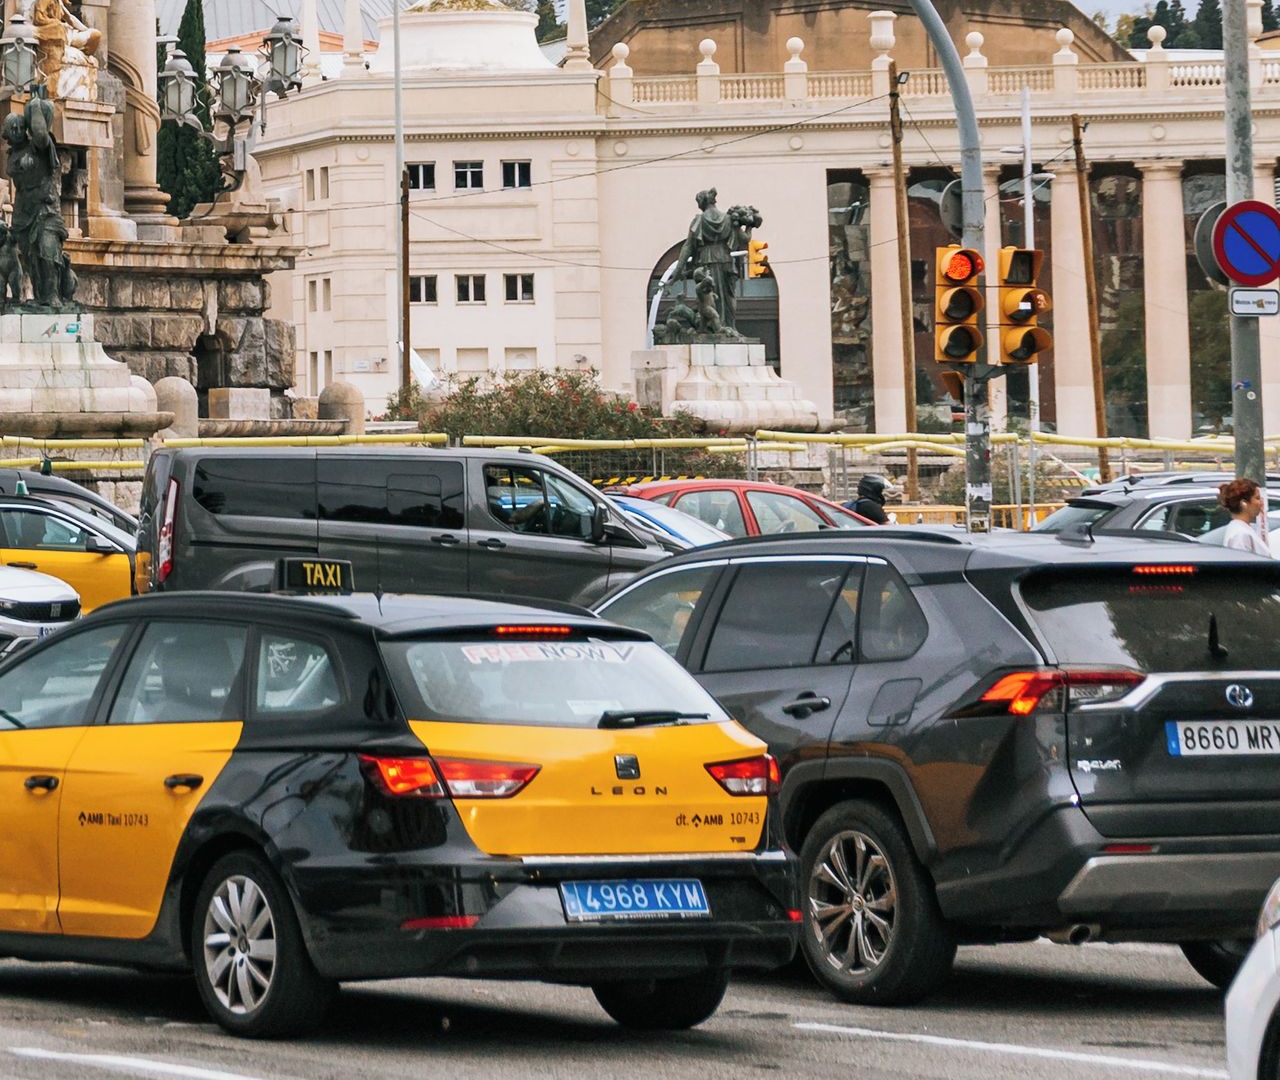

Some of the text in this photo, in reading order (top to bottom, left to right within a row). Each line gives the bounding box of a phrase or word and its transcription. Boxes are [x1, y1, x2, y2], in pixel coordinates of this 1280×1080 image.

[302, 561, 342, 587] TAXI
[1183, 726, 1239, 751] 8660
[591, 786, 668, 796] LEON
[87, 812, 149, 826] AMB Taxi 10743
[675, 812, 760, 826] dt. AMB 10743
[586, 883, 703, 910] 4968 KYM
